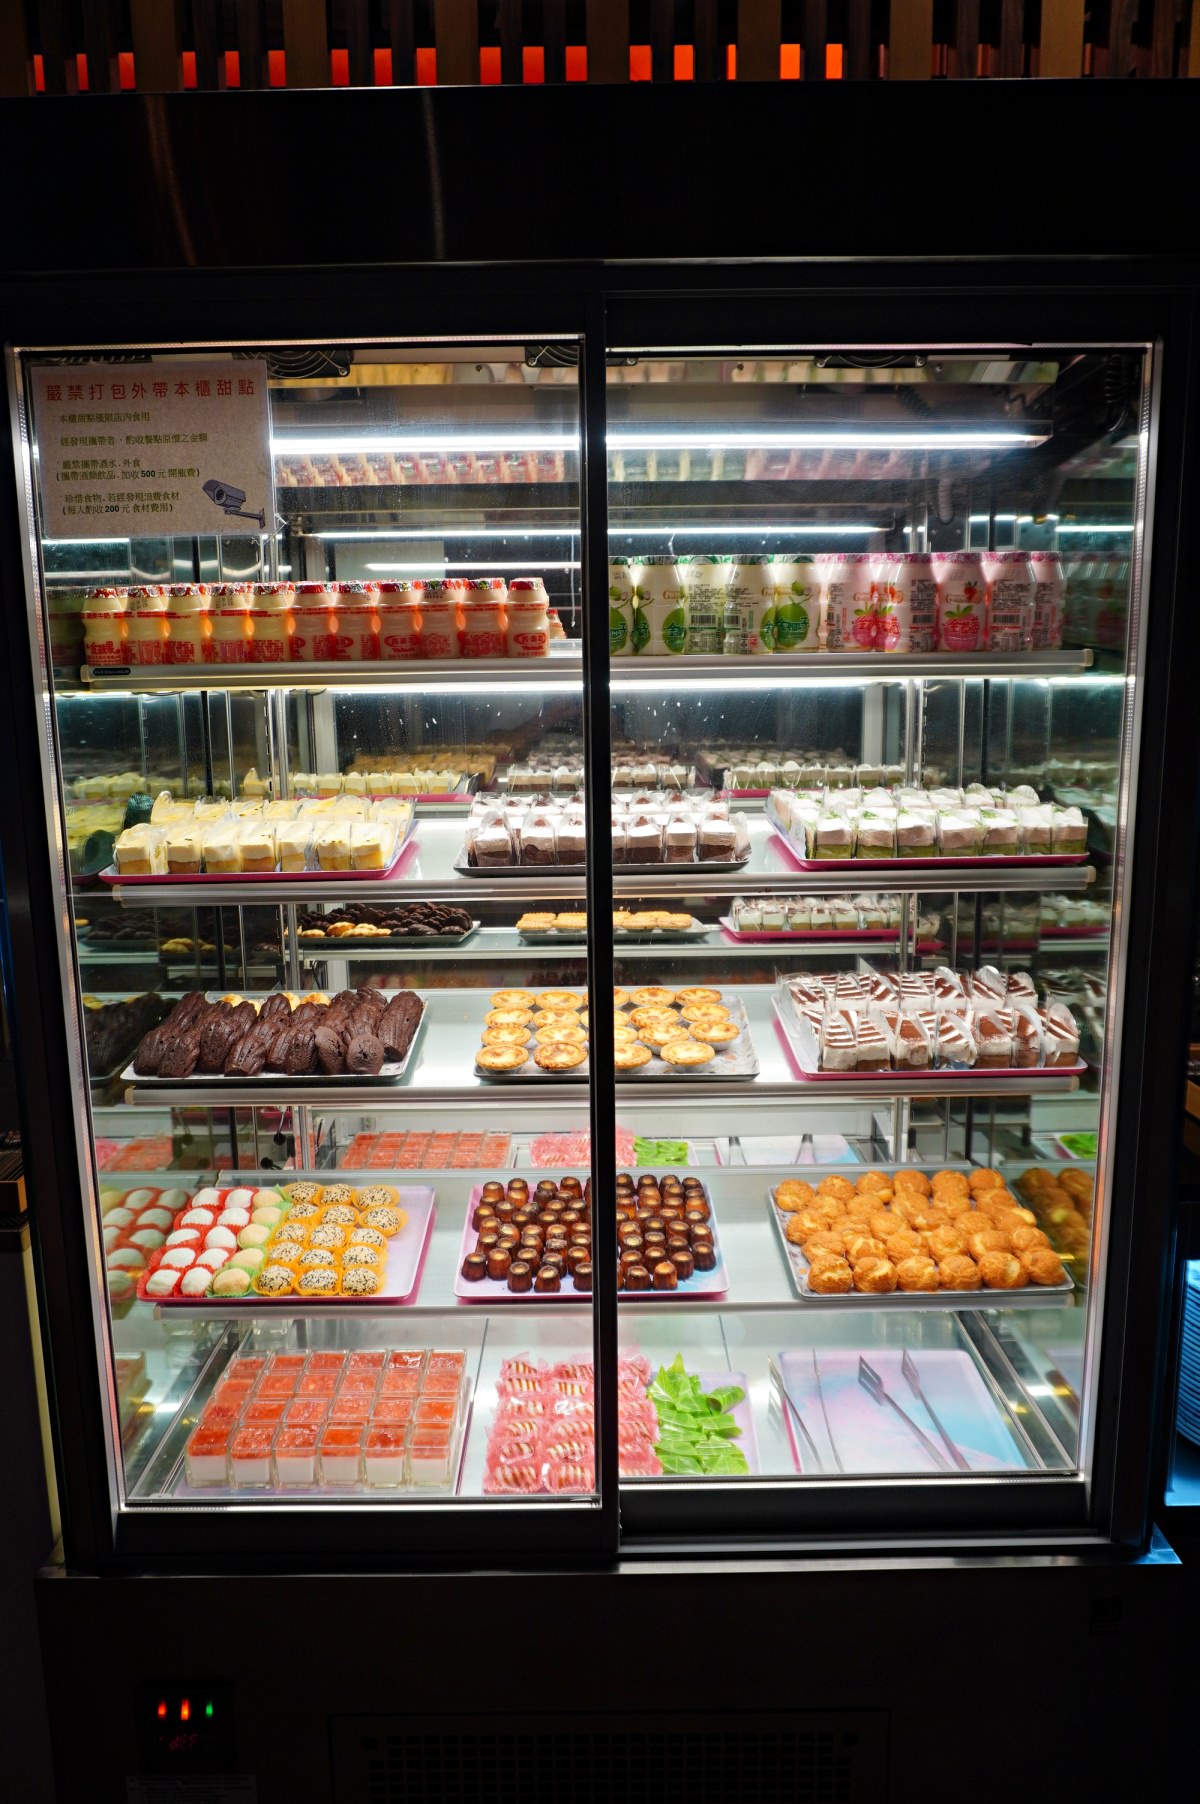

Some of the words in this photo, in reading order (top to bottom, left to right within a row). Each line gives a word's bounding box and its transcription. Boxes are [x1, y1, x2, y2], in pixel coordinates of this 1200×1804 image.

[47, 378, 255, 401] 嚴禁打包外帶本櫃甜點
